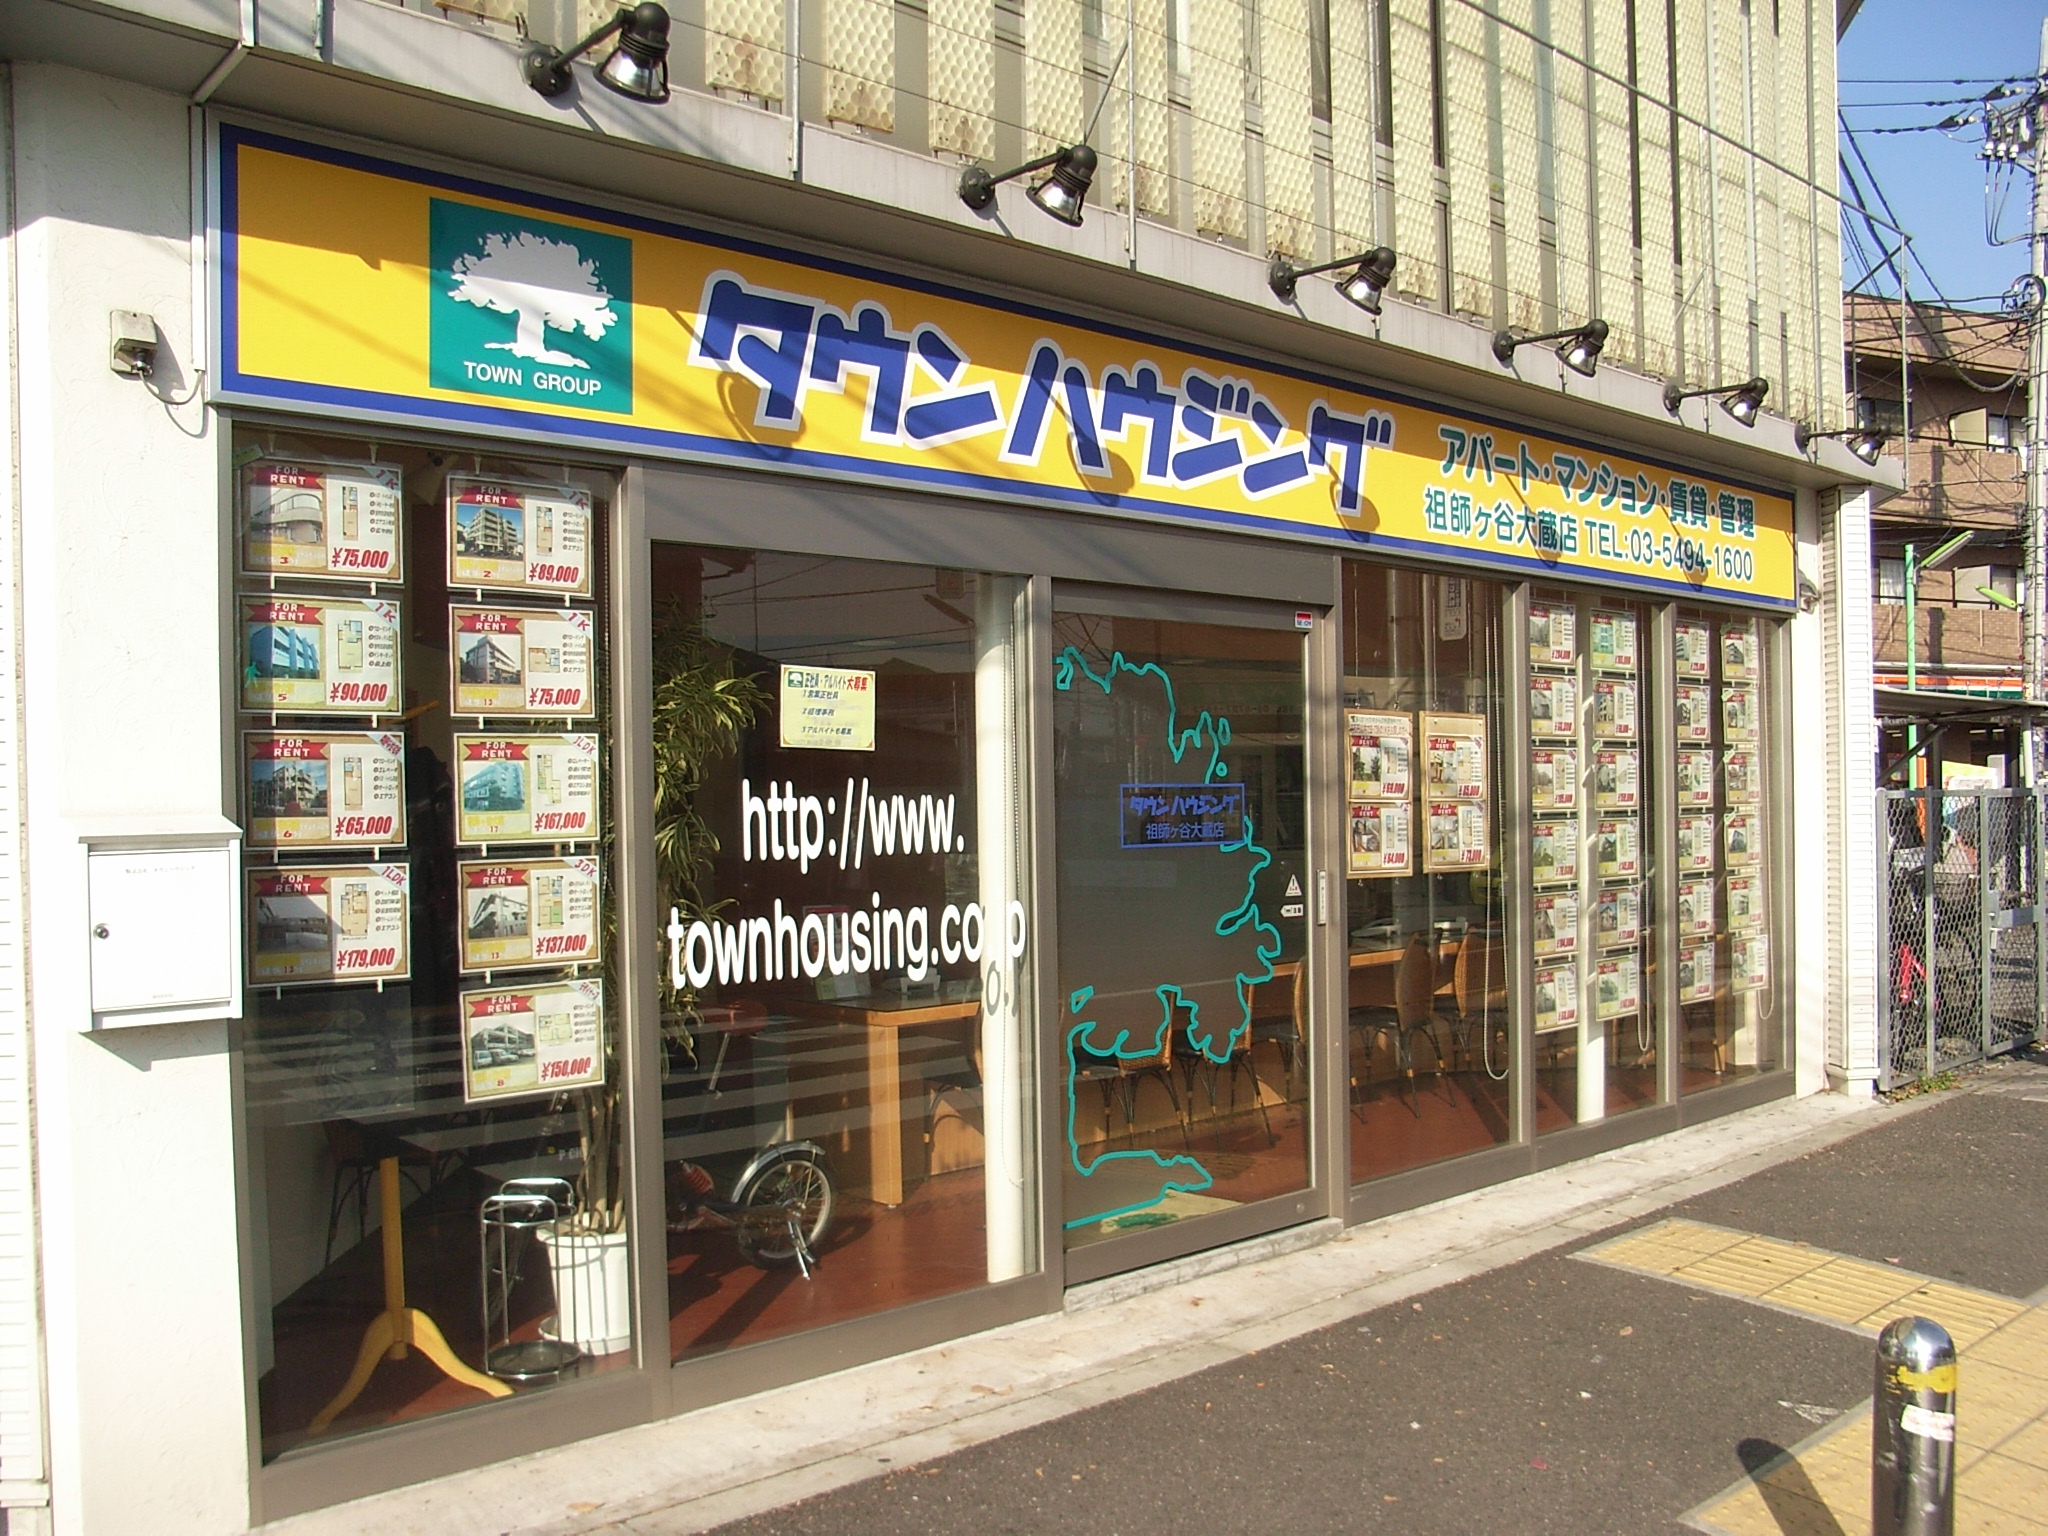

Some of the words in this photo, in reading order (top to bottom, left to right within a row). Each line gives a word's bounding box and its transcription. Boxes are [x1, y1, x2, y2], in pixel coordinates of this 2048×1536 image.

[464, 361, 522, 386] TOWN
[534, 373, 602, 396] GROUP
[693, 273, 1394, 516] タウンハウジング
[275, 466, 299, 475] FOR
[270, 475, 306, 485] RENT
[1438, 426, 1756, 538] アパート・マンション・賃貸・管理
[481, 486, 501, 495] FOR
[476, 495, 507, 504] RENT
[1585, 520, 1753, 582] TEL:03-5494-1600
[331, 547, 390, 569] ¥75,000
[529, 563, 579, 583] ¥89,000
[275, 603, 298, 611] FOR
[270, 611, 305, 621] RENT
[480, 614, 501, 622] FOR
[476, 622, 507, 631] RENT
[330, 682, 388, 703] ¥90,000
[529, 688, 581, 706] ¥75,000
[279, 739, 303, 748] FOR
[486, 741, 506, 749] FOR
[274, 748, 310, 757] RENT
[482, 750, 512, 758] RENT
[1130, 795, 1240, 816] タウンハウジング
[335, 816, 392, 837] ¥65,000
[535, 812, 586, 832] ¥167,000
[743, 777, 965, 874] http://www.
[487, 868, 507, 876] FOR
[575, 859, 597, 877] 3DK
[281, 875, 303, 883] FOR
[483, 876, 513, 885] RENT
[275, 884, 311, 893] RENT
[536, 934, 587, 956] ¥137,000
[667, 891, 1026, 989] townhousing.cop
[336, 948, 395, 971] ¥179,000
[492, 995, 512, 1004] FOR
[487, 1003, 518, 1013] RENT
[541, 1057, 591, 1081] ¥150,000
